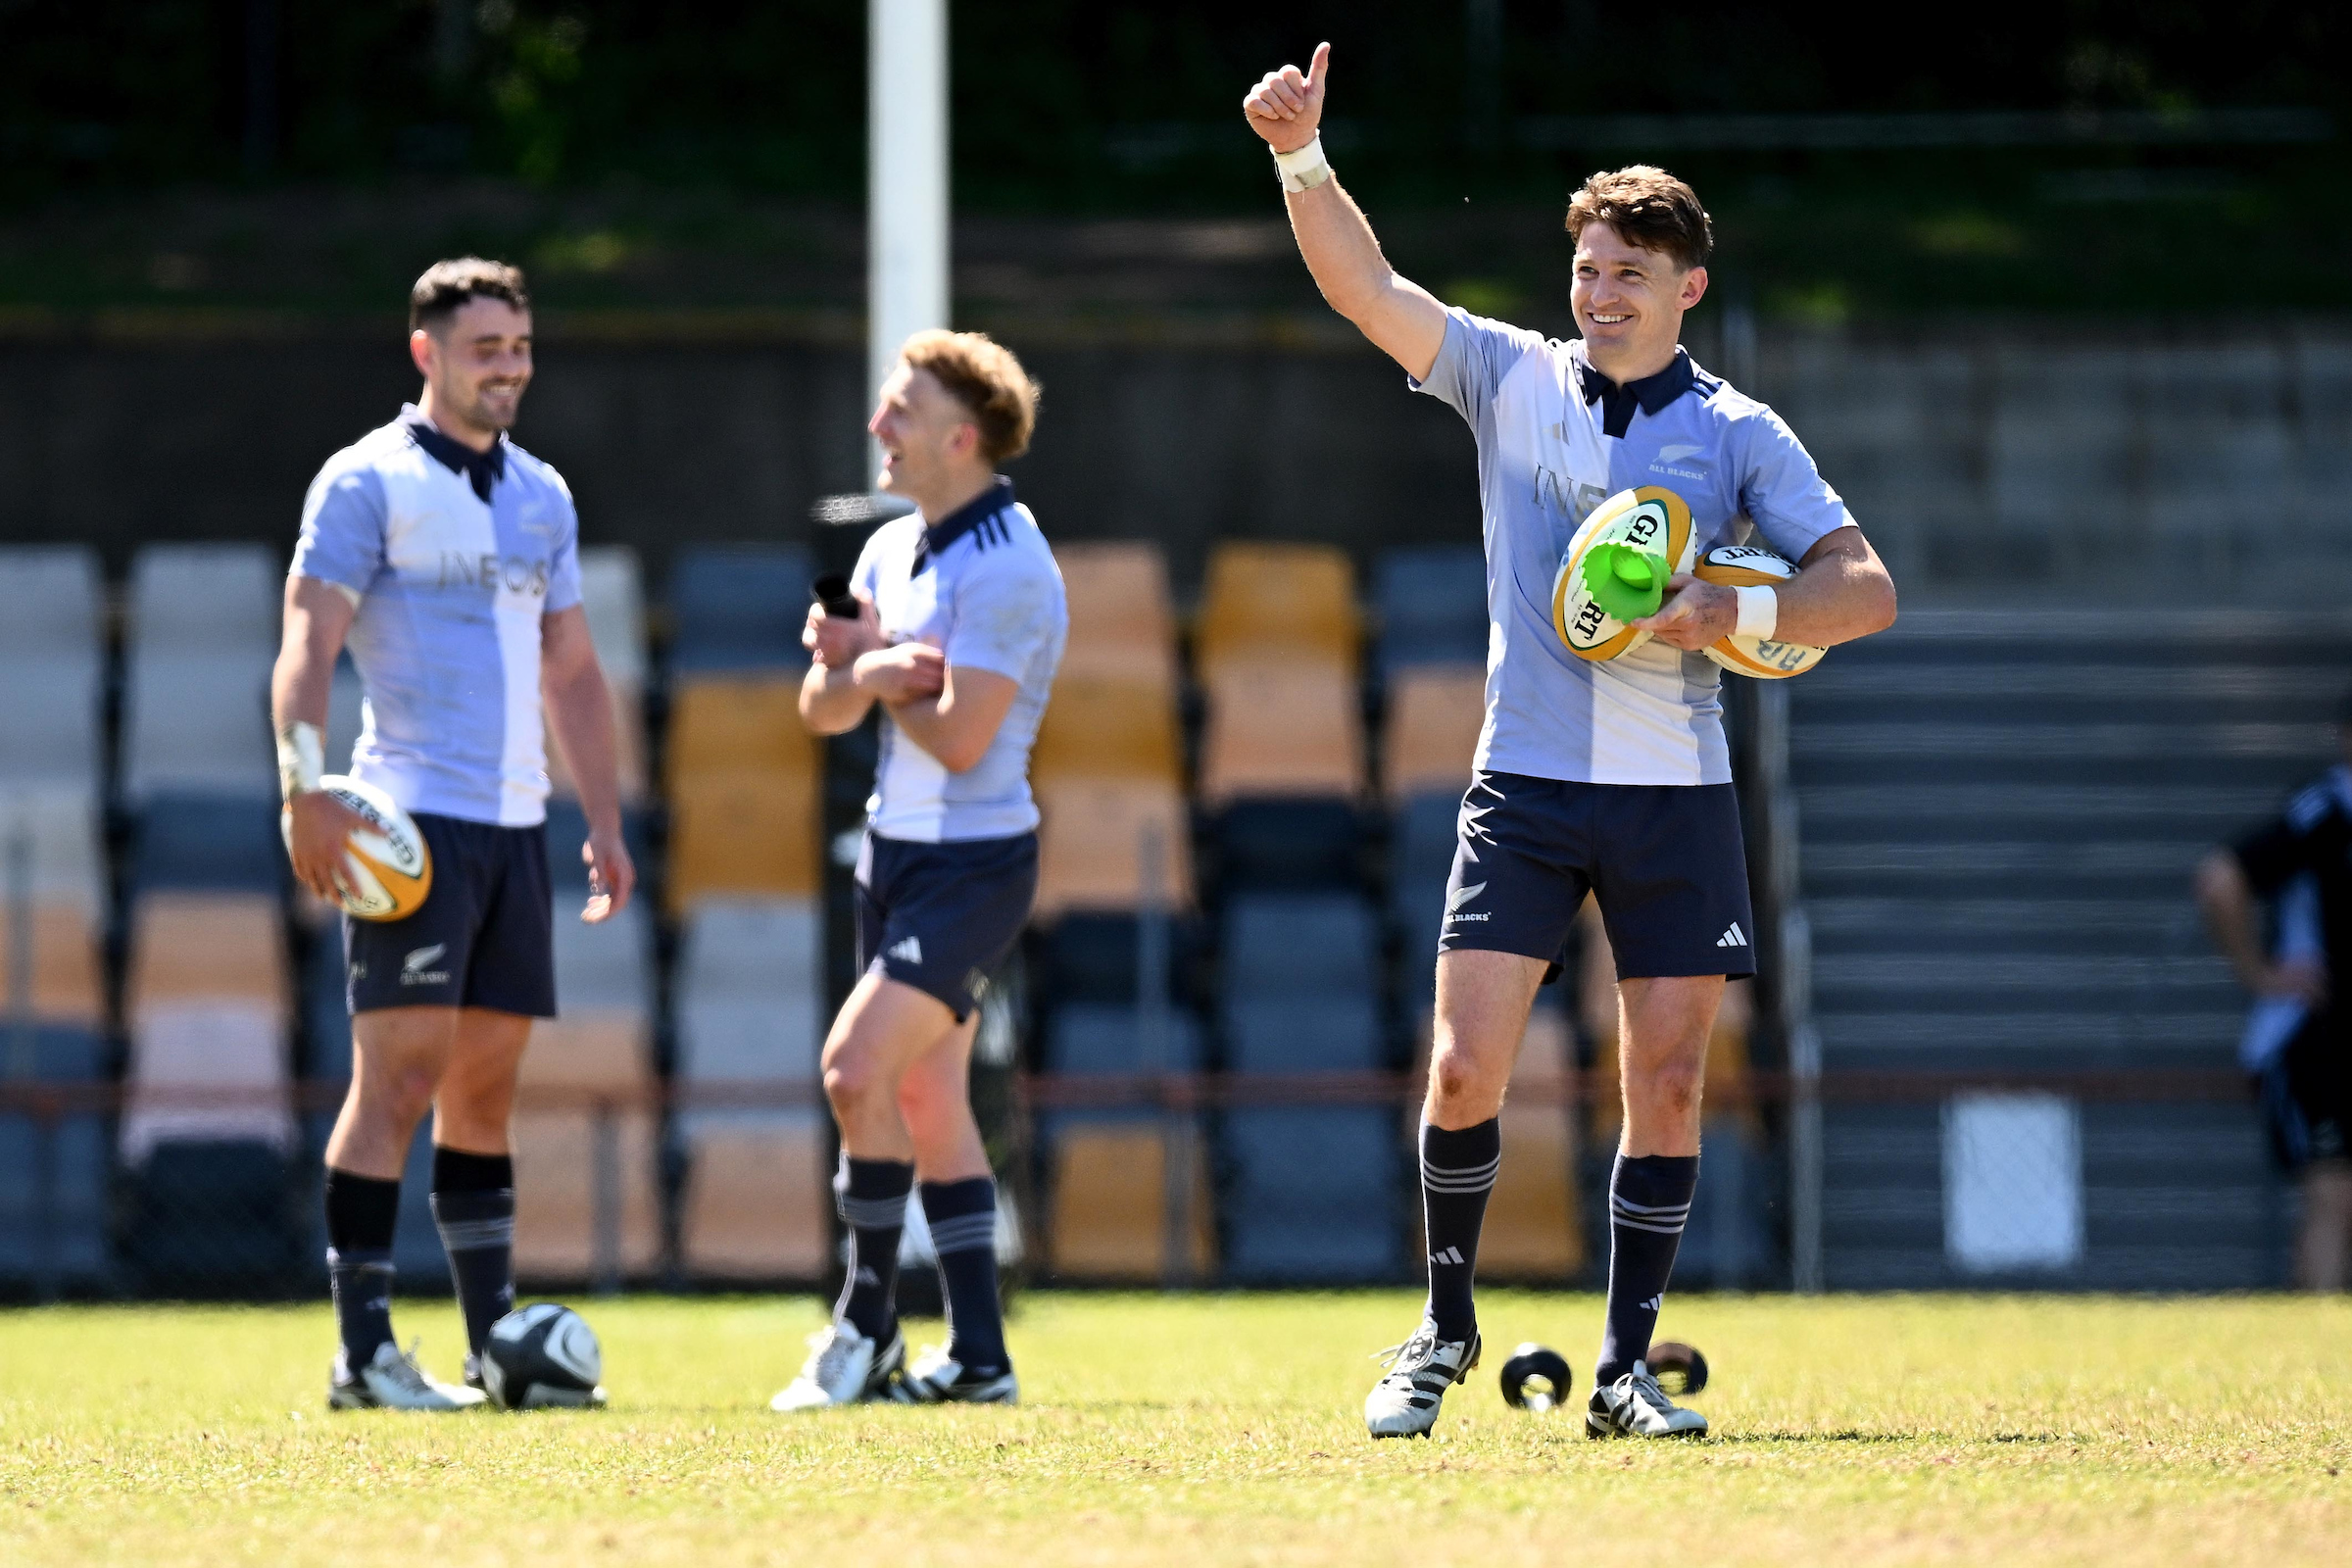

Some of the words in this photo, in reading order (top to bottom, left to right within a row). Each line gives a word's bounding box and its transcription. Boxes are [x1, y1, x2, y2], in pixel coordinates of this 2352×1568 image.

[1648, 464, 1665, 473] ALL
[1667, 467, 1704, 480] BLACKS
[1532, 462, 1607, 525] INE
[436, 550, 547, 597] INEOS
[1455, 913, 1490, 922] BLACKS
